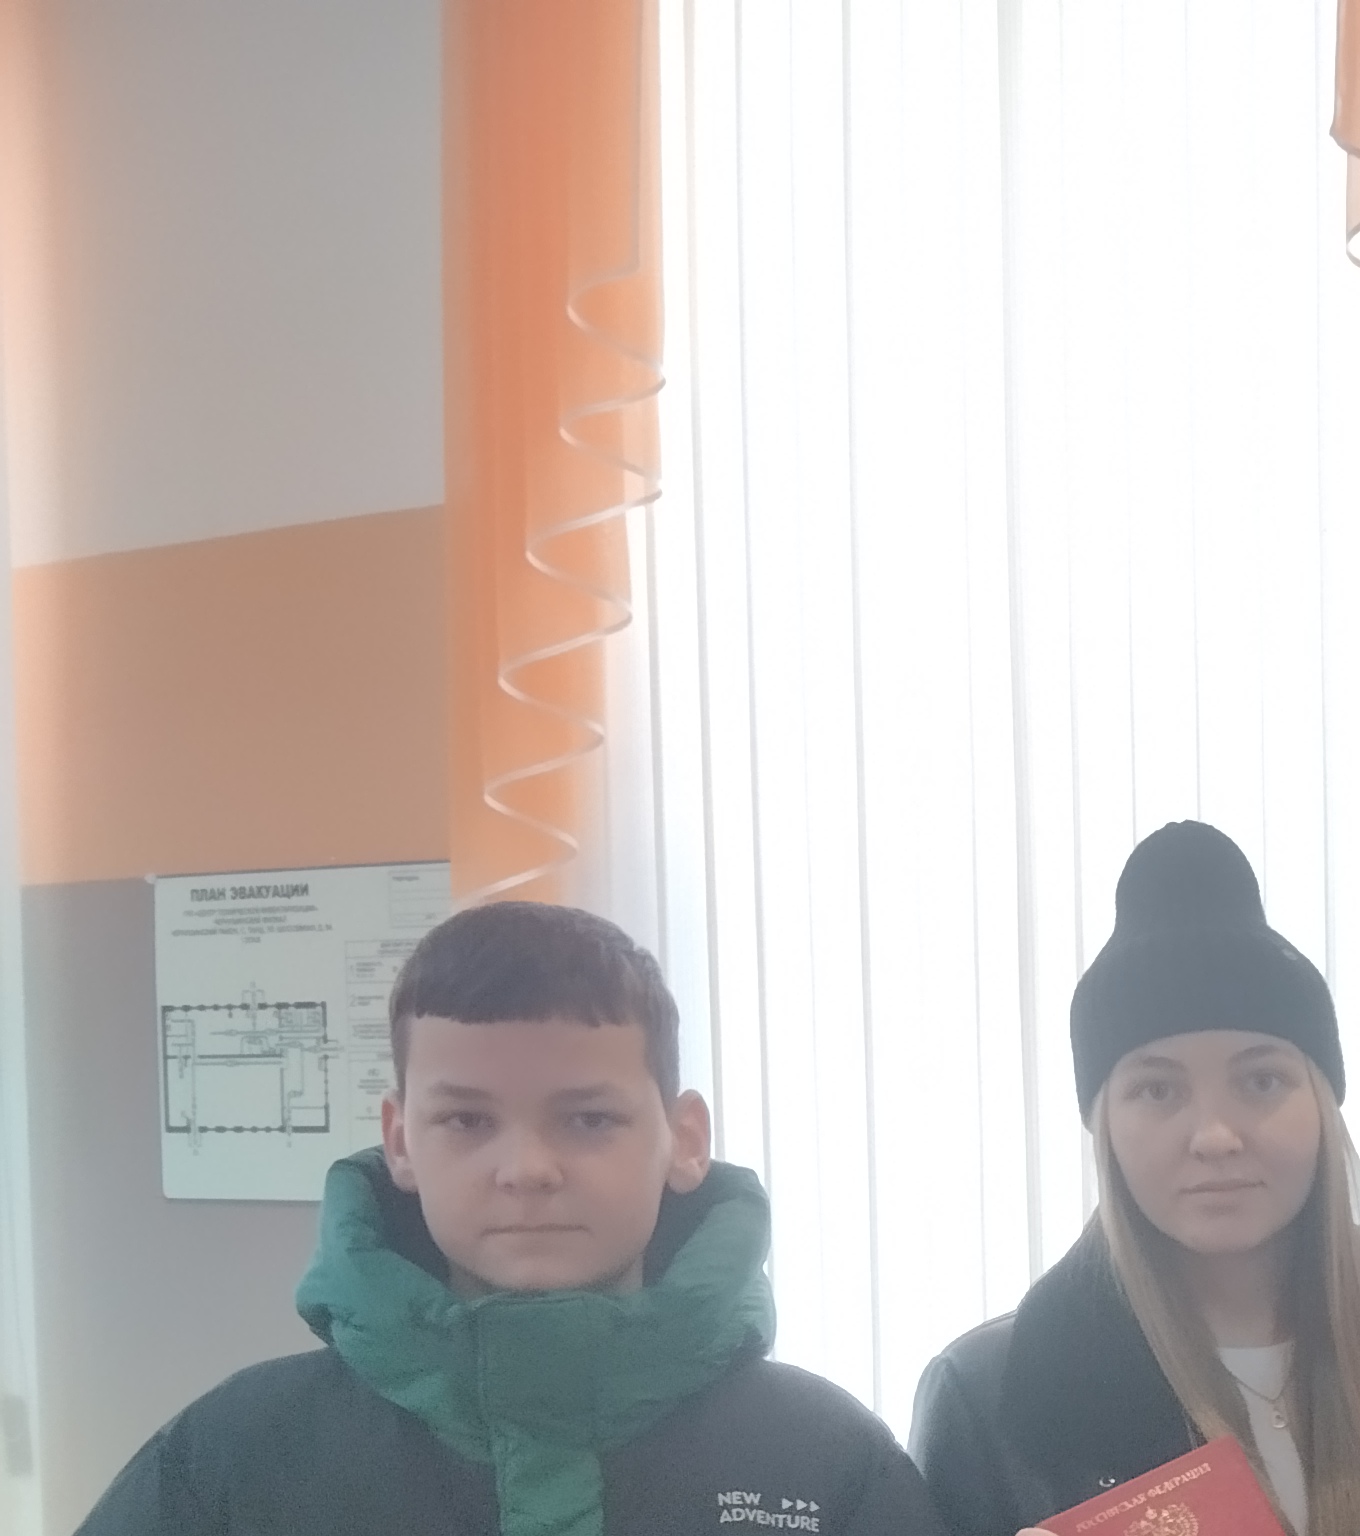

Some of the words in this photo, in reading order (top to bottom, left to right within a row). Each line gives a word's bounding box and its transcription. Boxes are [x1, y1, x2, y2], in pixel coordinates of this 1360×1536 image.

[190, 887, 227, 902] ПЛАН
[229, 883, 310, 900] ЭВАКУАЦИИ
[717, 1490, 762, 1506] NEW
[719, 1507, 820, 1533] ADVENTURE
